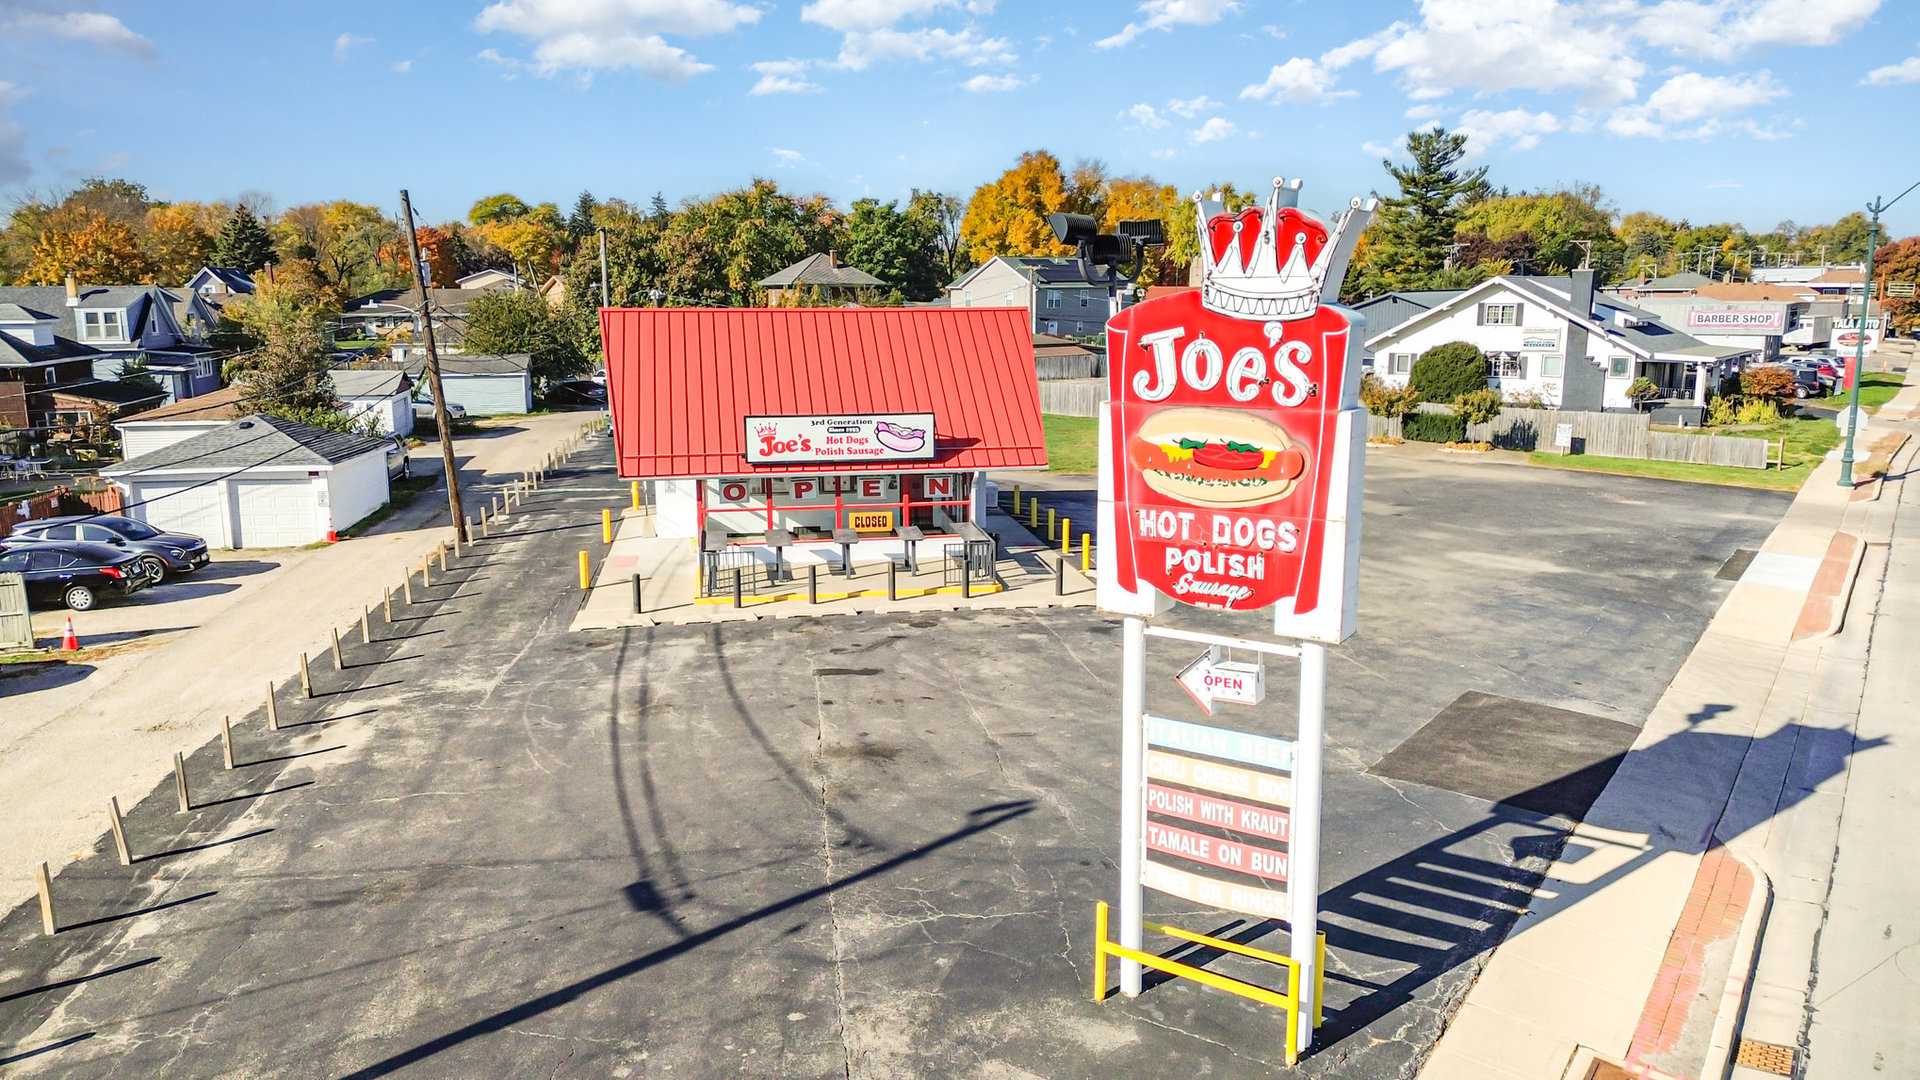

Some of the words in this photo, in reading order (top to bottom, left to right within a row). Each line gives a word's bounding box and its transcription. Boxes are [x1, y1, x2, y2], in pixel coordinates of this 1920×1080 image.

[1696, 314, 1740, 324] BARBER
[1742, 314, 1773, 324] SHOP
[1833, 319, 1854, 329] TALA
[1132, 321, 1313, 408] Joe's
[827, 418, 873, 426] Generation
[759, 433, 812, 457] Joe's
[826, 435, 844, 446] Hot
[846, 436, 869, 447] Dogs
[815, 446, 845, 456] Polish
[847, 446, 885, 457] Sausage
[854, 515, 887, 528] CLOSED
[1137, 509, 1197, 540] HOT
[1212, 515, 1298, 553] DOGS
[1165, 547, 1265, 580] POLISH
[1173, 573, 1254, 609] Sausage
[1204, 675, 1243, 691] OPEN
[1148, 790, 1193, 817] POLISH
[1200, 801, 1234, 826] WITH
[1241, 809, 1288, 838] KRAUT
[1148, 825, 1209, 859] TAMALE
[1218, 843, 1242, 866] ON
[1251, 851, 1288, 878] BUN
